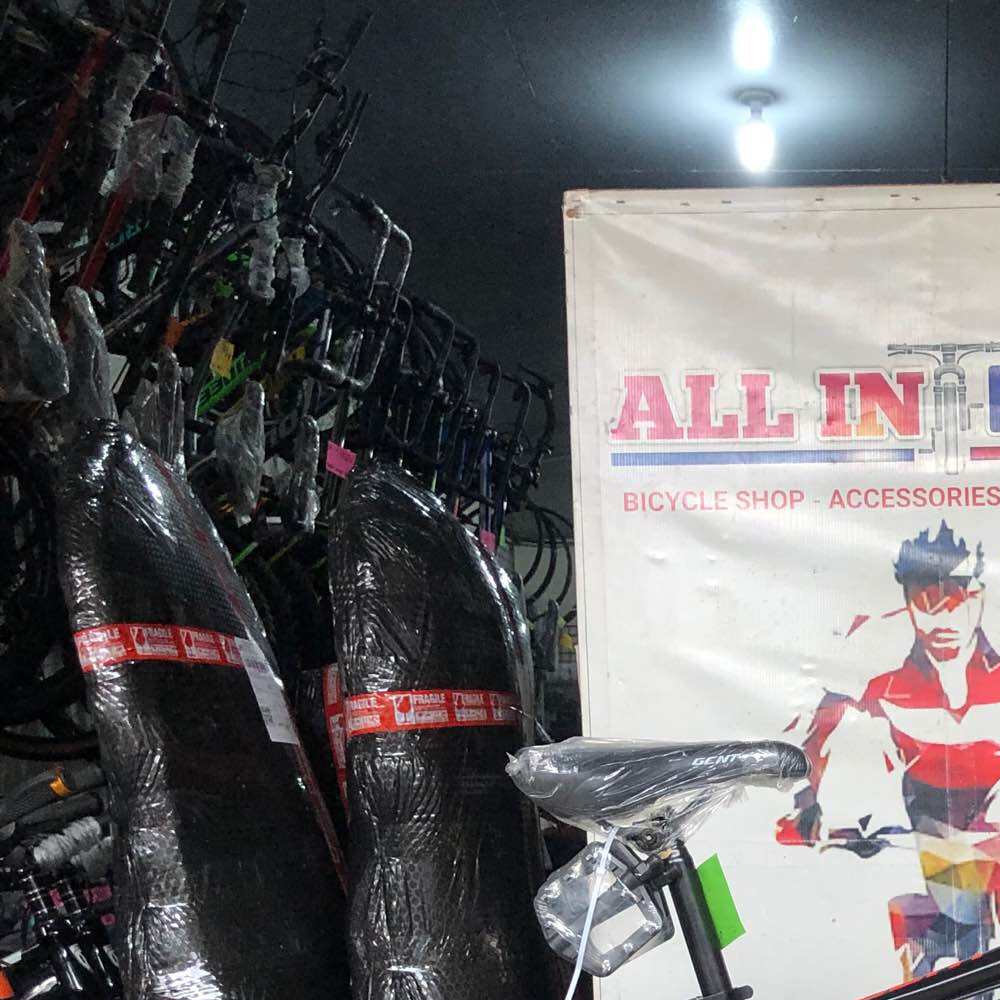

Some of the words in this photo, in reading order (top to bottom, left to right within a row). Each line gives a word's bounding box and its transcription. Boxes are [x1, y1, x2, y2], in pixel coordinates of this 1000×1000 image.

[610, 373, 795, 441] ALL
[818, 371, 926, 438] IN
[623, 490, 728, 512] BICYCLE
[736, 489, 805, 511] SHOP
[829, 486, 1000, 509] ACCESSORIES
[691, 752, 738, 767] GENT
